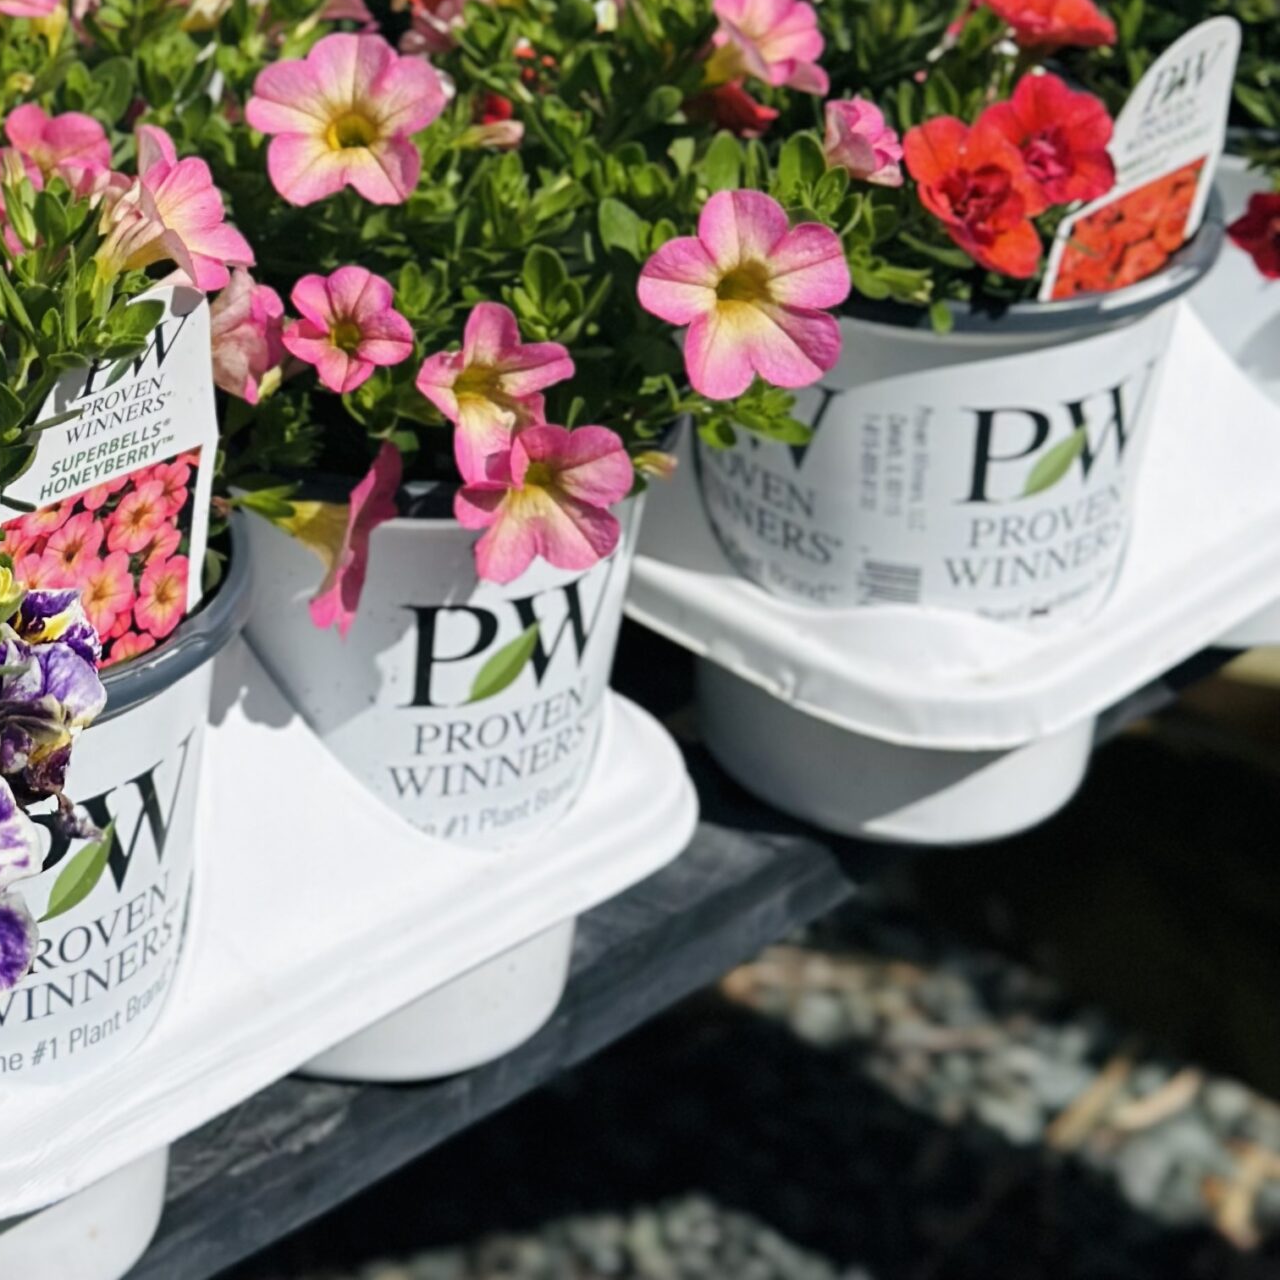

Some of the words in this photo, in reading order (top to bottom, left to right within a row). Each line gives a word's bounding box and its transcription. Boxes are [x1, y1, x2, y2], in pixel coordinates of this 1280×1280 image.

[66, 392, 168, 445] WINNERS
[79, 373, 166, 420] PROVEN
[951, 358, 1158, 507] PW
[394, 554, 616, 709] PW
[413, 676, 588, 756] PROVEN
[28, 872, 171, 975] ROVEN
[32, 1035, 59, 1067] #1
[69, 1008, 122, 1055] Plant
